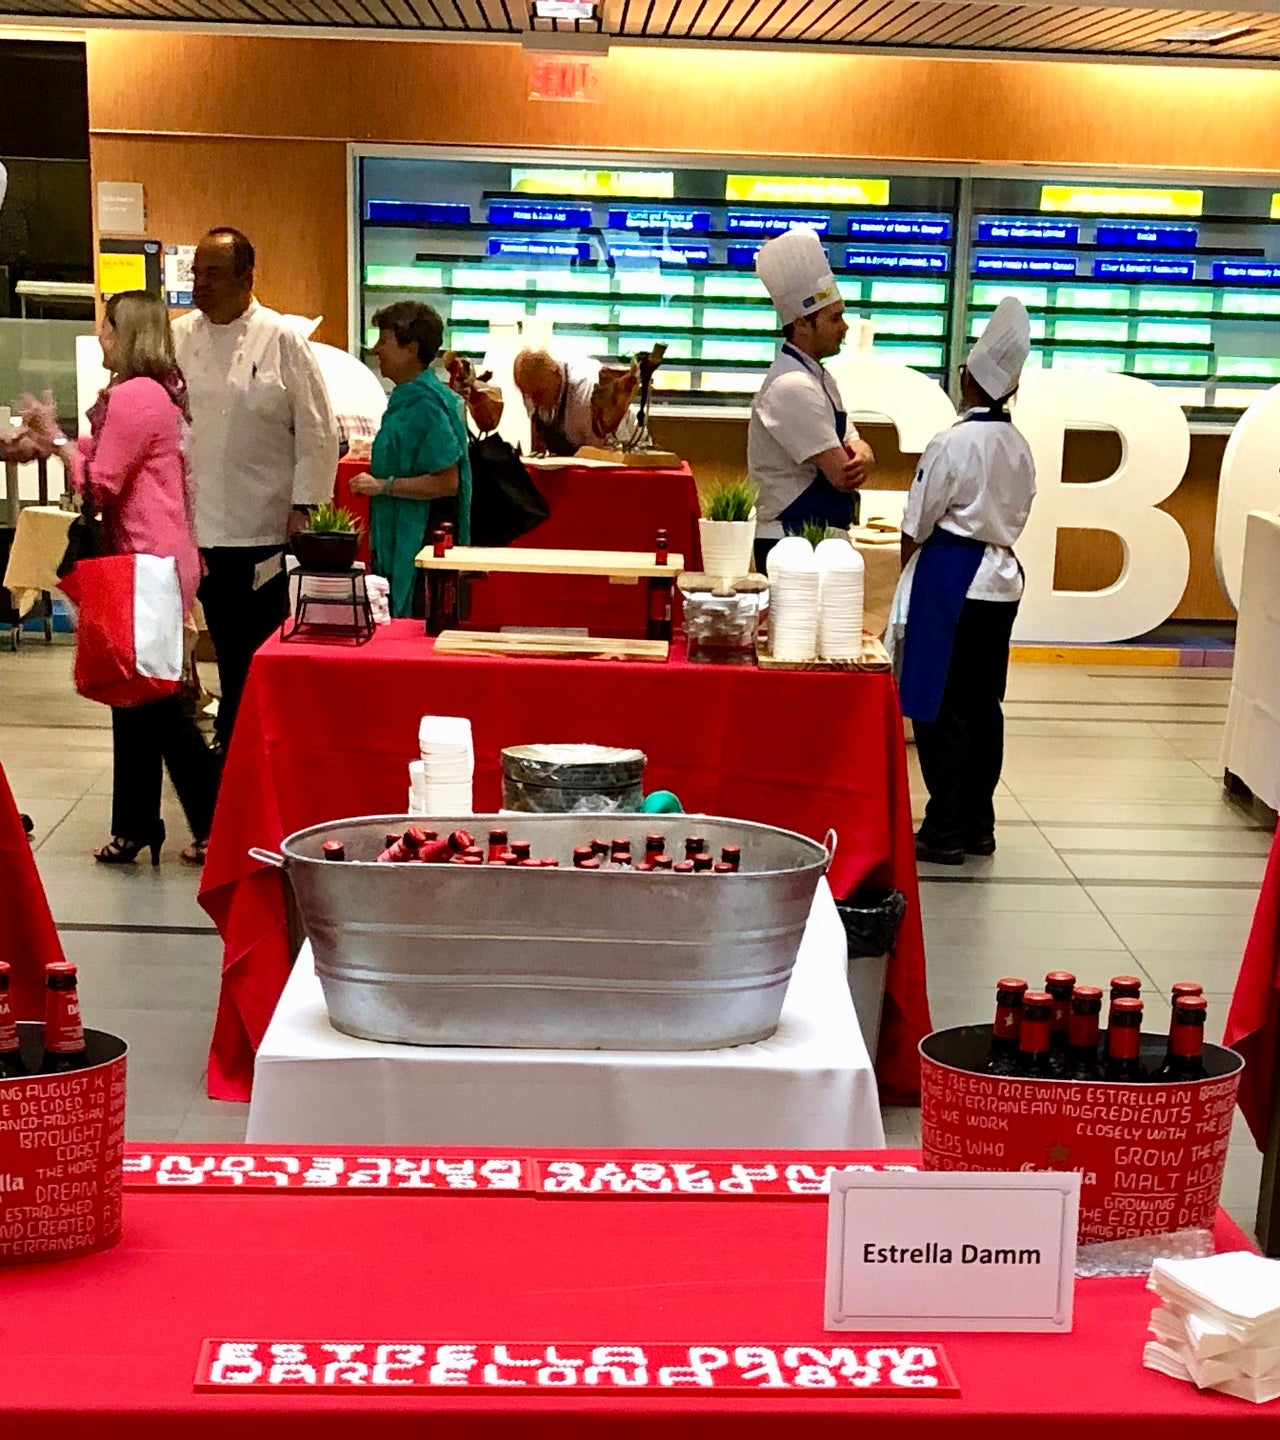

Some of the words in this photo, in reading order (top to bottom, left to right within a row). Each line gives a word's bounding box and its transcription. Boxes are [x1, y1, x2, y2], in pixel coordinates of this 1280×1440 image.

[1115, 1145, 1184, 1167] GROW
[1114, 1170, 1180, 1191] MALT
[863, 1242, 952, 1264] Estrella
[961, 1243, 1041, 1265] Damm
[219, 1343, 649, 1367] ESTRELLA
[690, 1345, 938, 1369] DAMM
